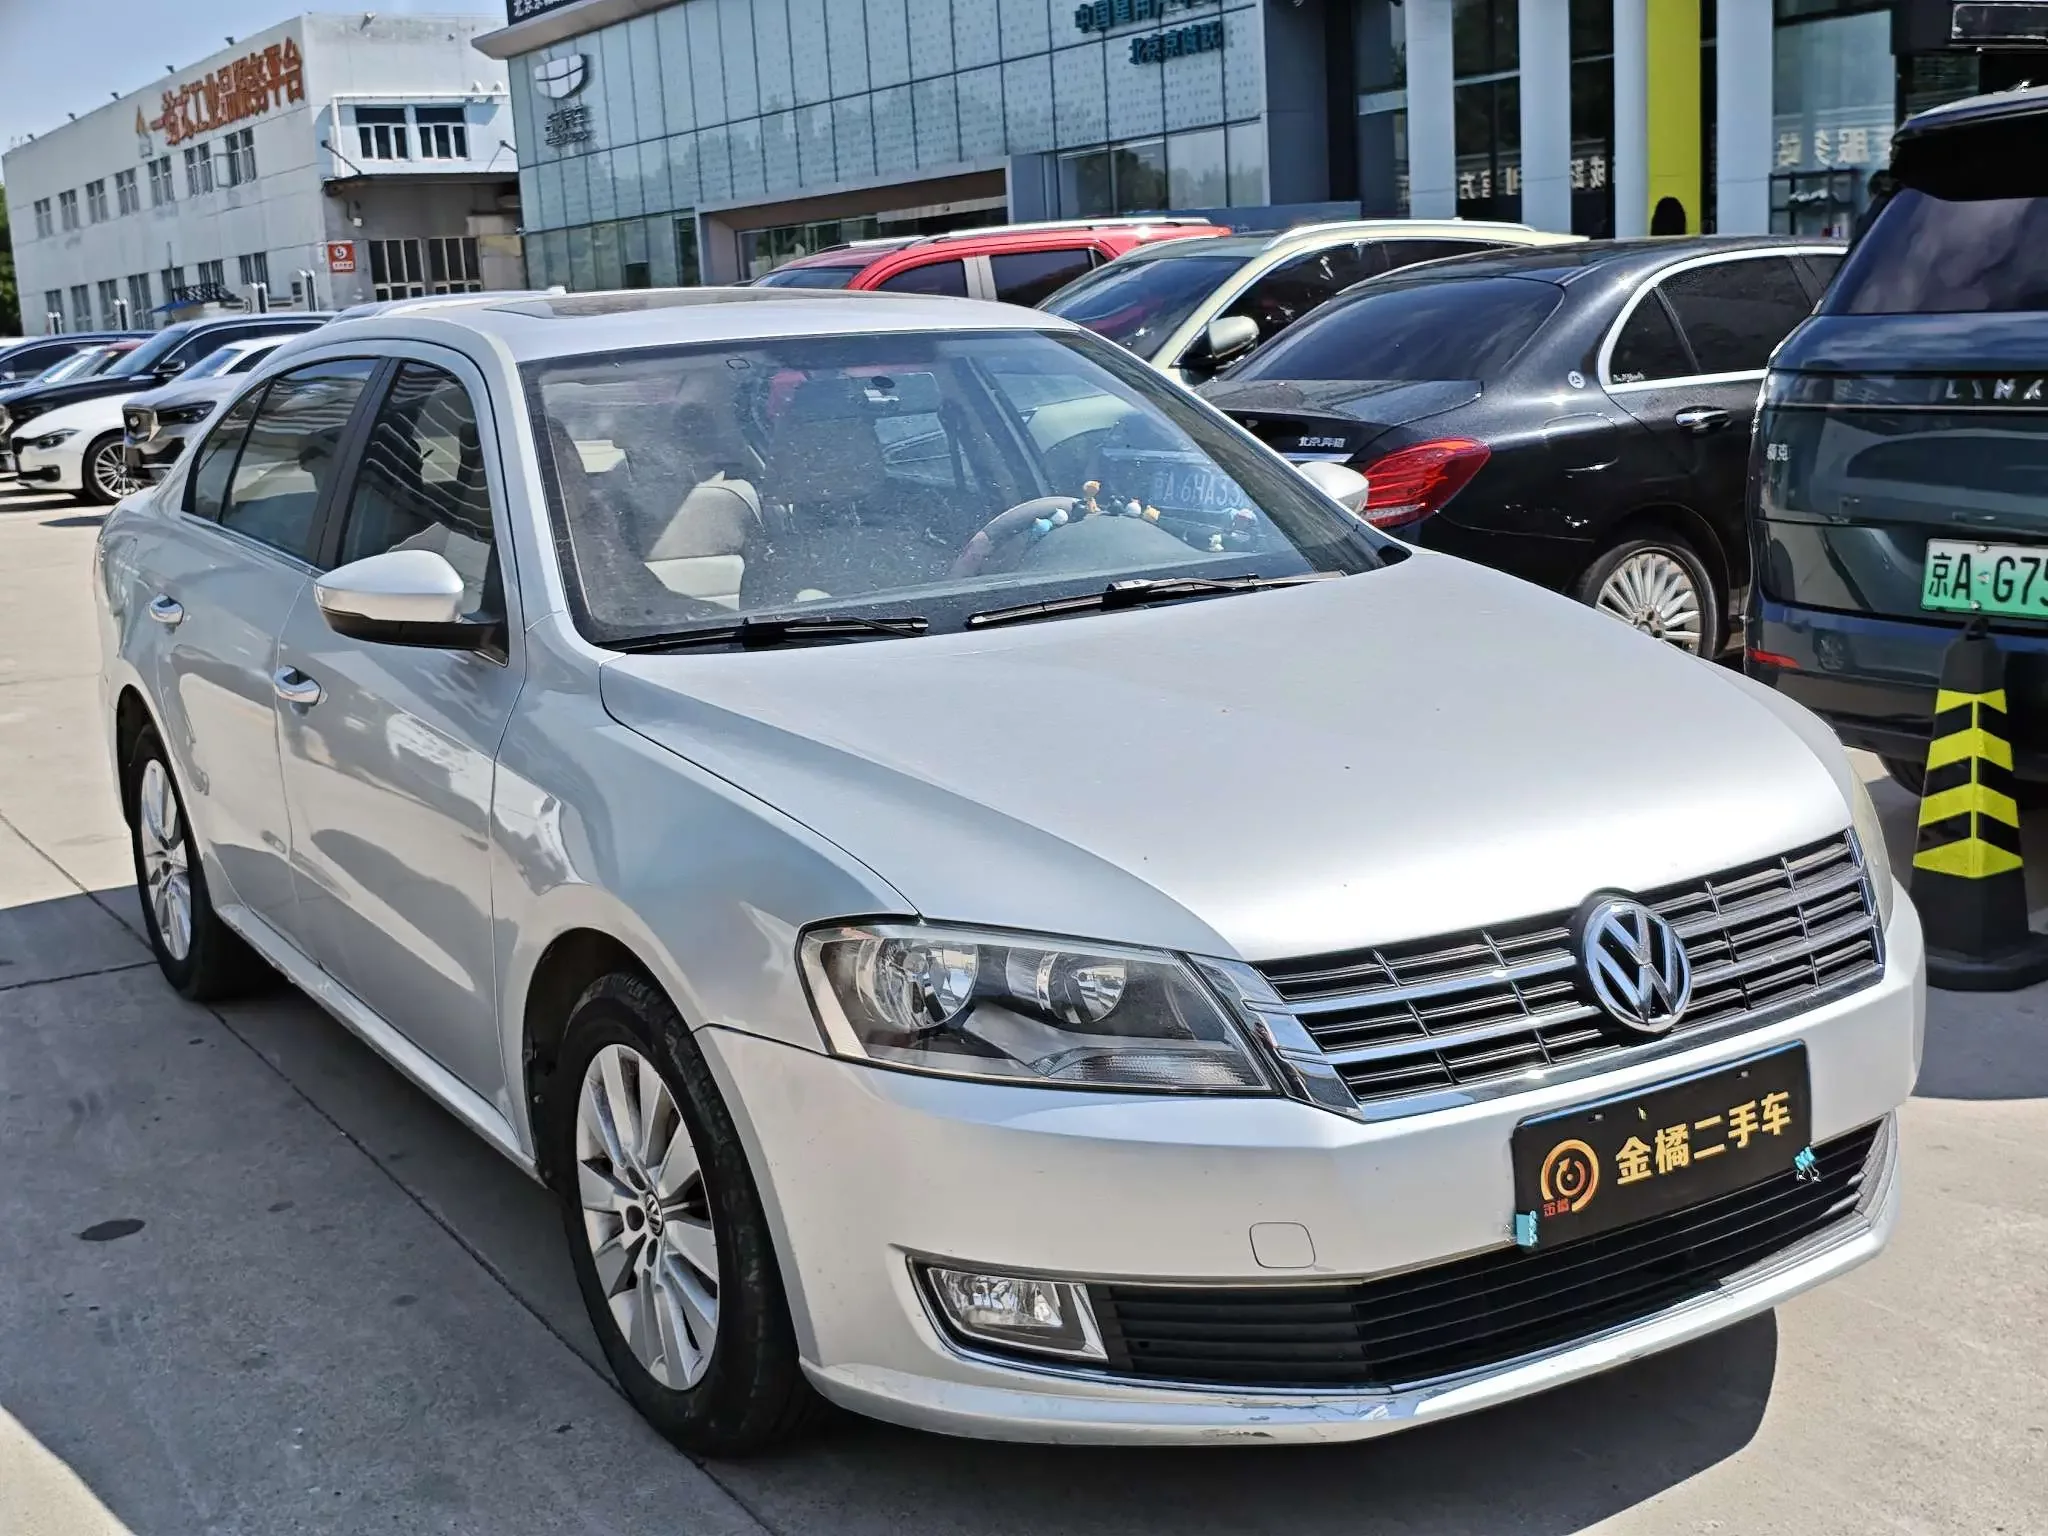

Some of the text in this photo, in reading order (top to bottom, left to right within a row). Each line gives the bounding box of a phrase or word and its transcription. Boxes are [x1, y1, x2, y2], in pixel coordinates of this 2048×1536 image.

[1615, 1091, 1793, 1186] 金橘二手车
